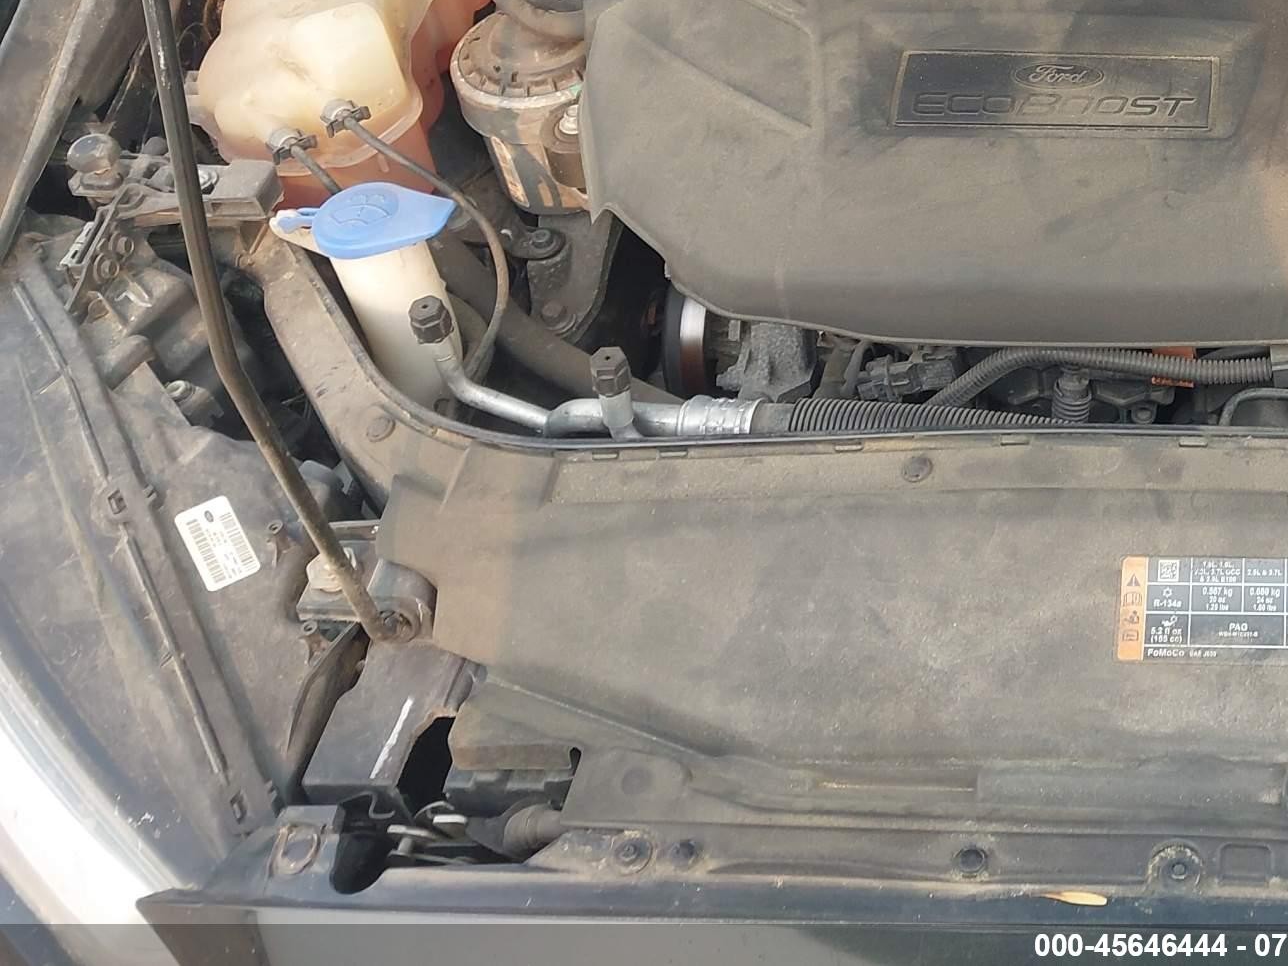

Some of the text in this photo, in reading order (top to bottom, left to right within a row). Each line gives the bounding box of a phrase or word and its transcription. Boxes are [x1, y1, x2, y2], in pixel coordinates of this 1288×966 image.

[1028, 64, 1086, 84] Ford
[911, 91, 1198, 117] ECOBOOST
[1153, 598, 1183, 608] R-134a
[1147, 648, 1185, 657] FoMoCo
